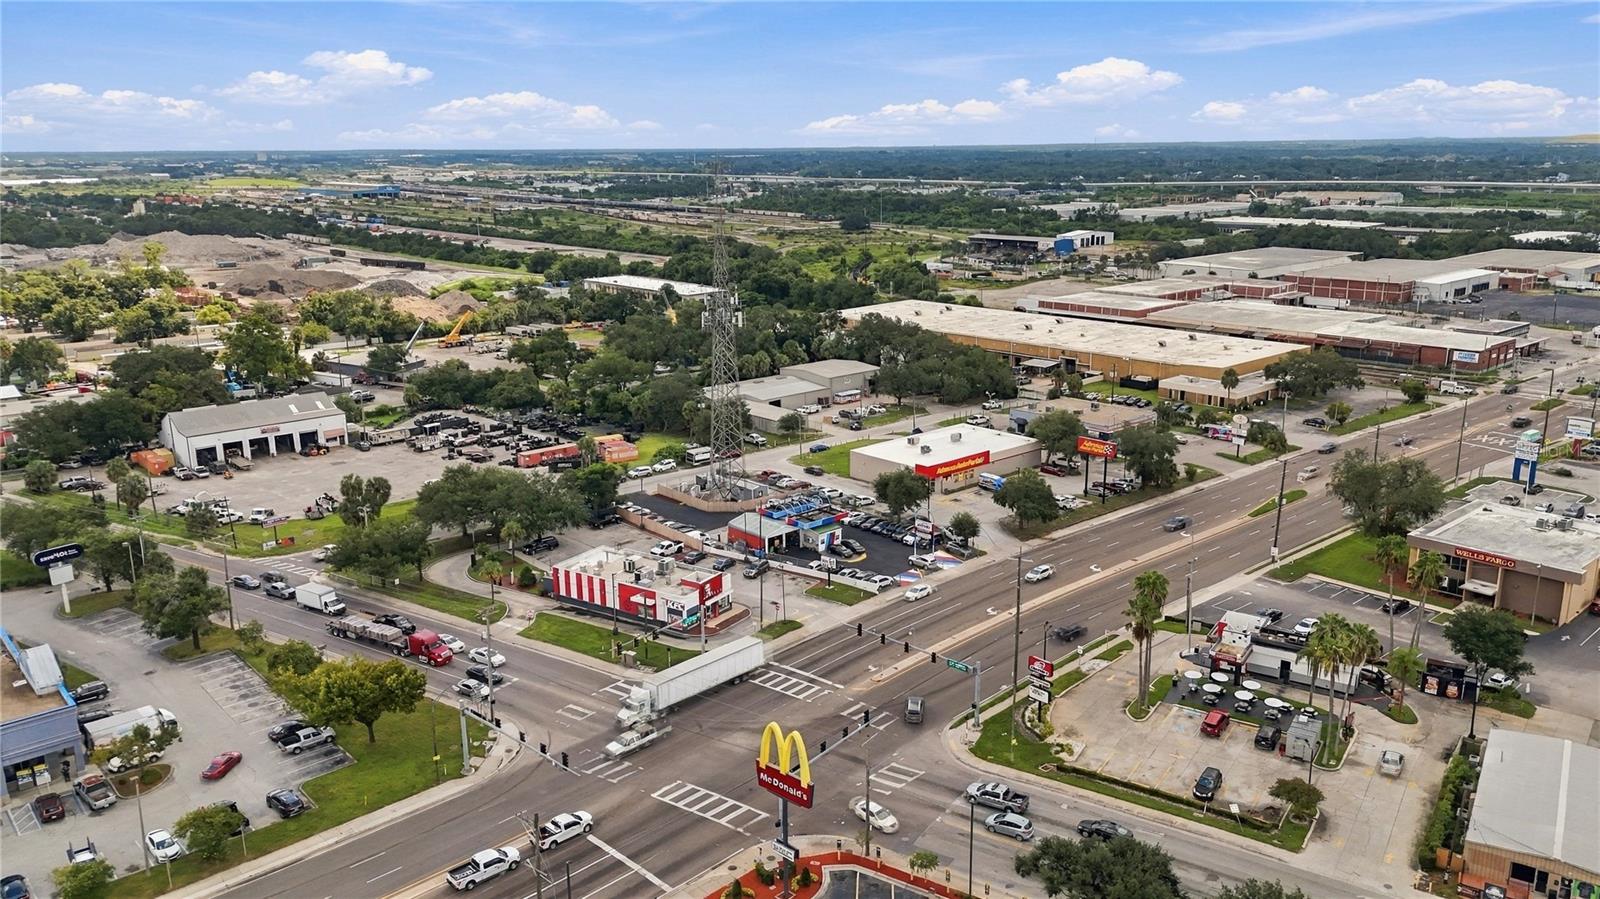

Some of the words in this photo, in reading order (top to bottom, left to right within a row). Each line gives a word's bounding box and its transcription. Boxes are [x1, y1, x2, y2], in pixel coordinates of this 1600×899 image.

[1456, 549, 1485, 561] WELLS
[1485, 556, 1515, 568] FARGO
[667, 600, 685, 610] KFC
